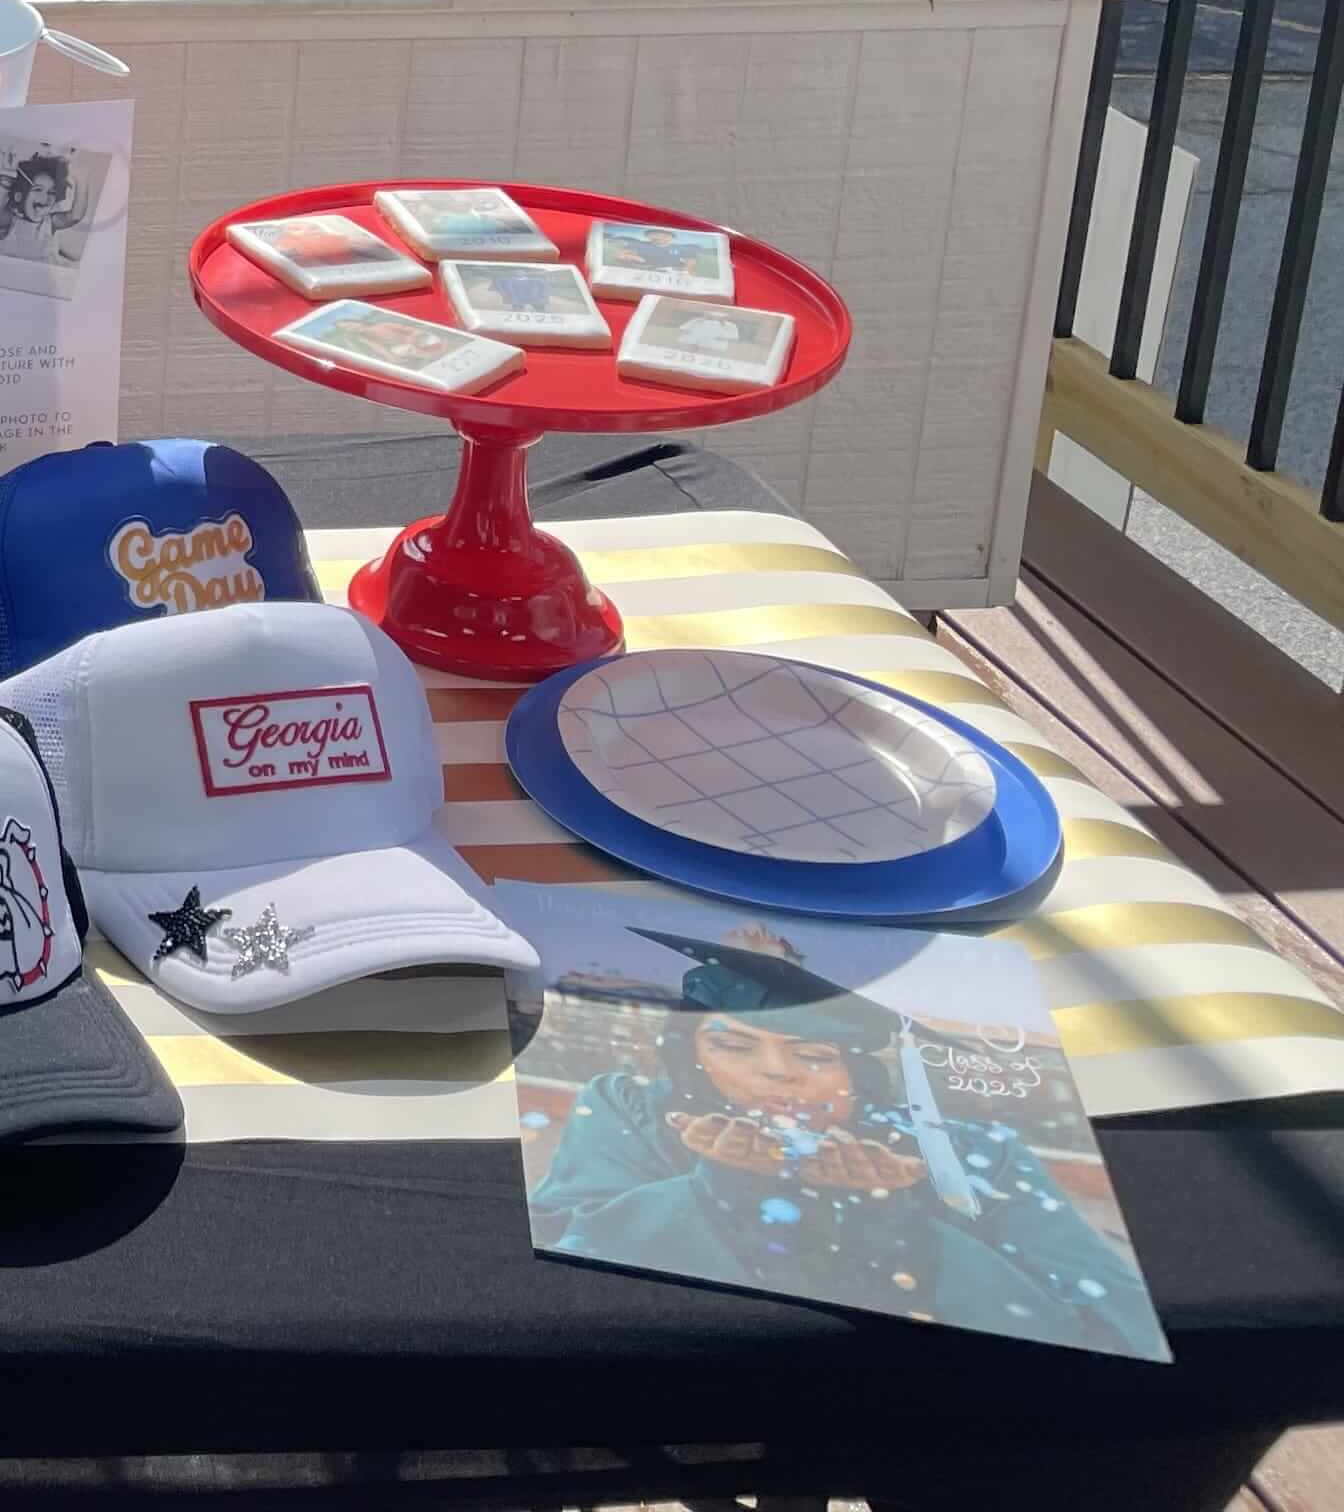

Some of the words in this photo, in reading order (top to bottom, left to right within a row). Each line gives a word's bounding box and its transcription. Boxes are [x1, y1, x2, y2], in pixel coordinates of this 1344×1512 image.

[28, 344, 57, 356] AND
[39, 357, 76, 369] WITH
[0, 413, 48, 425] PHOTO
[55, 411, 72, 422] TO
[28, 426, 44, 437] IN
[49, 424, 73, 436] THE
[118, 519, 250, 604] Game
[161, 569, 263, 612] Day
[223, 701, 363, 769] Georgia
[248, 760, 277, 779] on
[288, 751, 318, 778] my
[328, 749, 370, 771] mind
[919, 1043, 1003, 1074] Class
[1009, 1056, 1041, 1087] of
